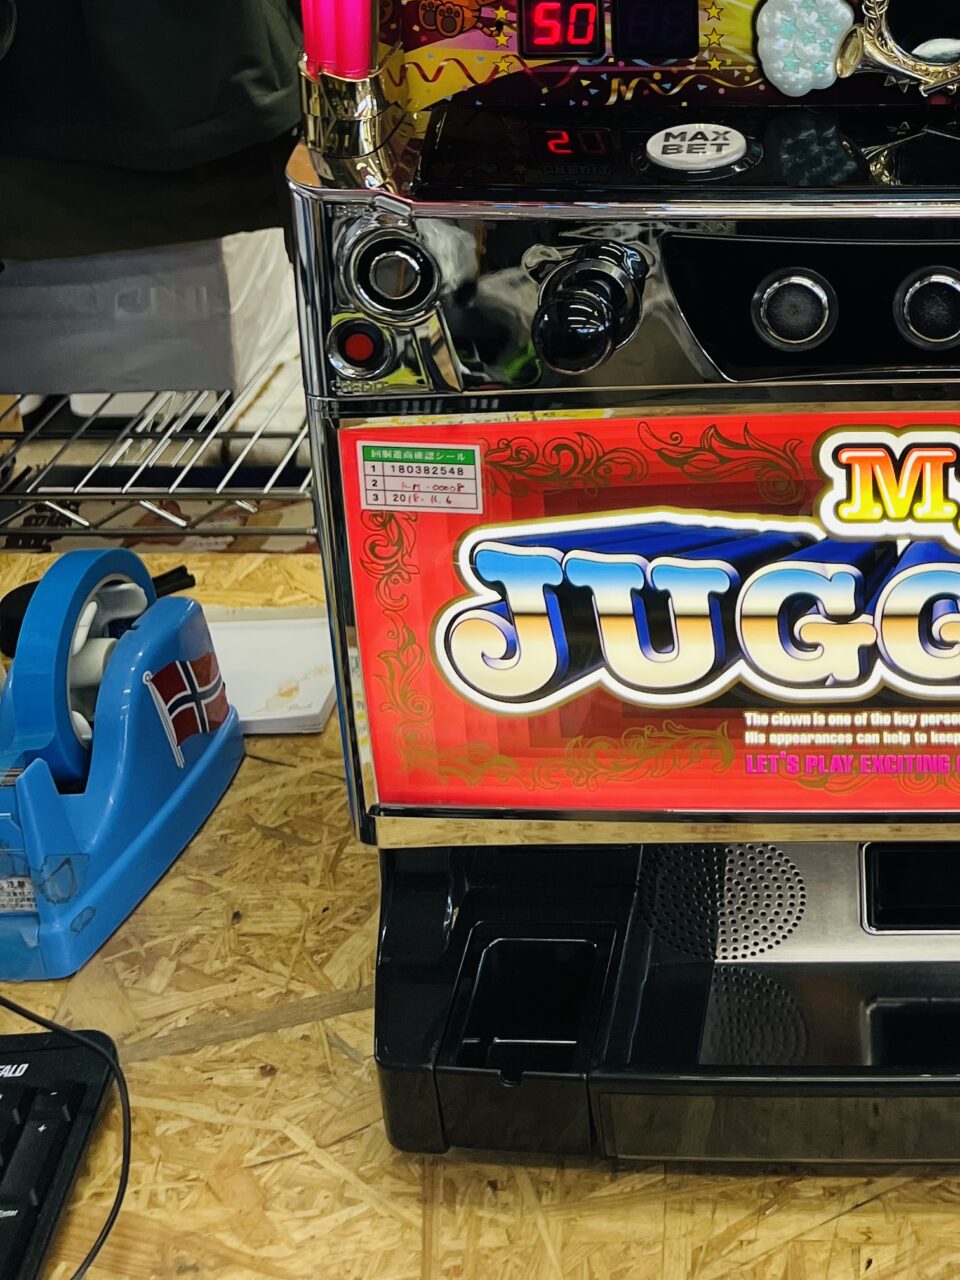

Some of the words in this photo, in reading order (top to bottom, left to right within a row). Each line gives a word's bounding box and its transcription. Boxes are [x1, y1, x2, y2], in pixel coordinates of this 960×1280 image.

[533, 1, 597, 46] 50
[663, 130, 732, 142] MAX
[661, 143, 730, 155] BET
[370, 465, 376, 473] 1
[390, 465, 464, 476] 180382548
[372, 494, 379, 502] 3
[744, 712, 769, 726] The
[771, 712, 811, 726] clown
[813, 712, 825, 726] is
[828, 713, 852, 726] one
[854, 712, 868, 726] of
[870, 711, 891, 726] the
[893, 711, 917, 728] key
[744, 731, 766, 745] His
[769, 732, 853, 746] appearances
[856, 732, 880, 745] can
[882, 731, 911, 746] help
[914, 731, 928, 744] to
[746, 751, 800, 774] LET'S
[805, 754, 853, 773] PLAY
[860, 754, 950, 773] EXCITING
